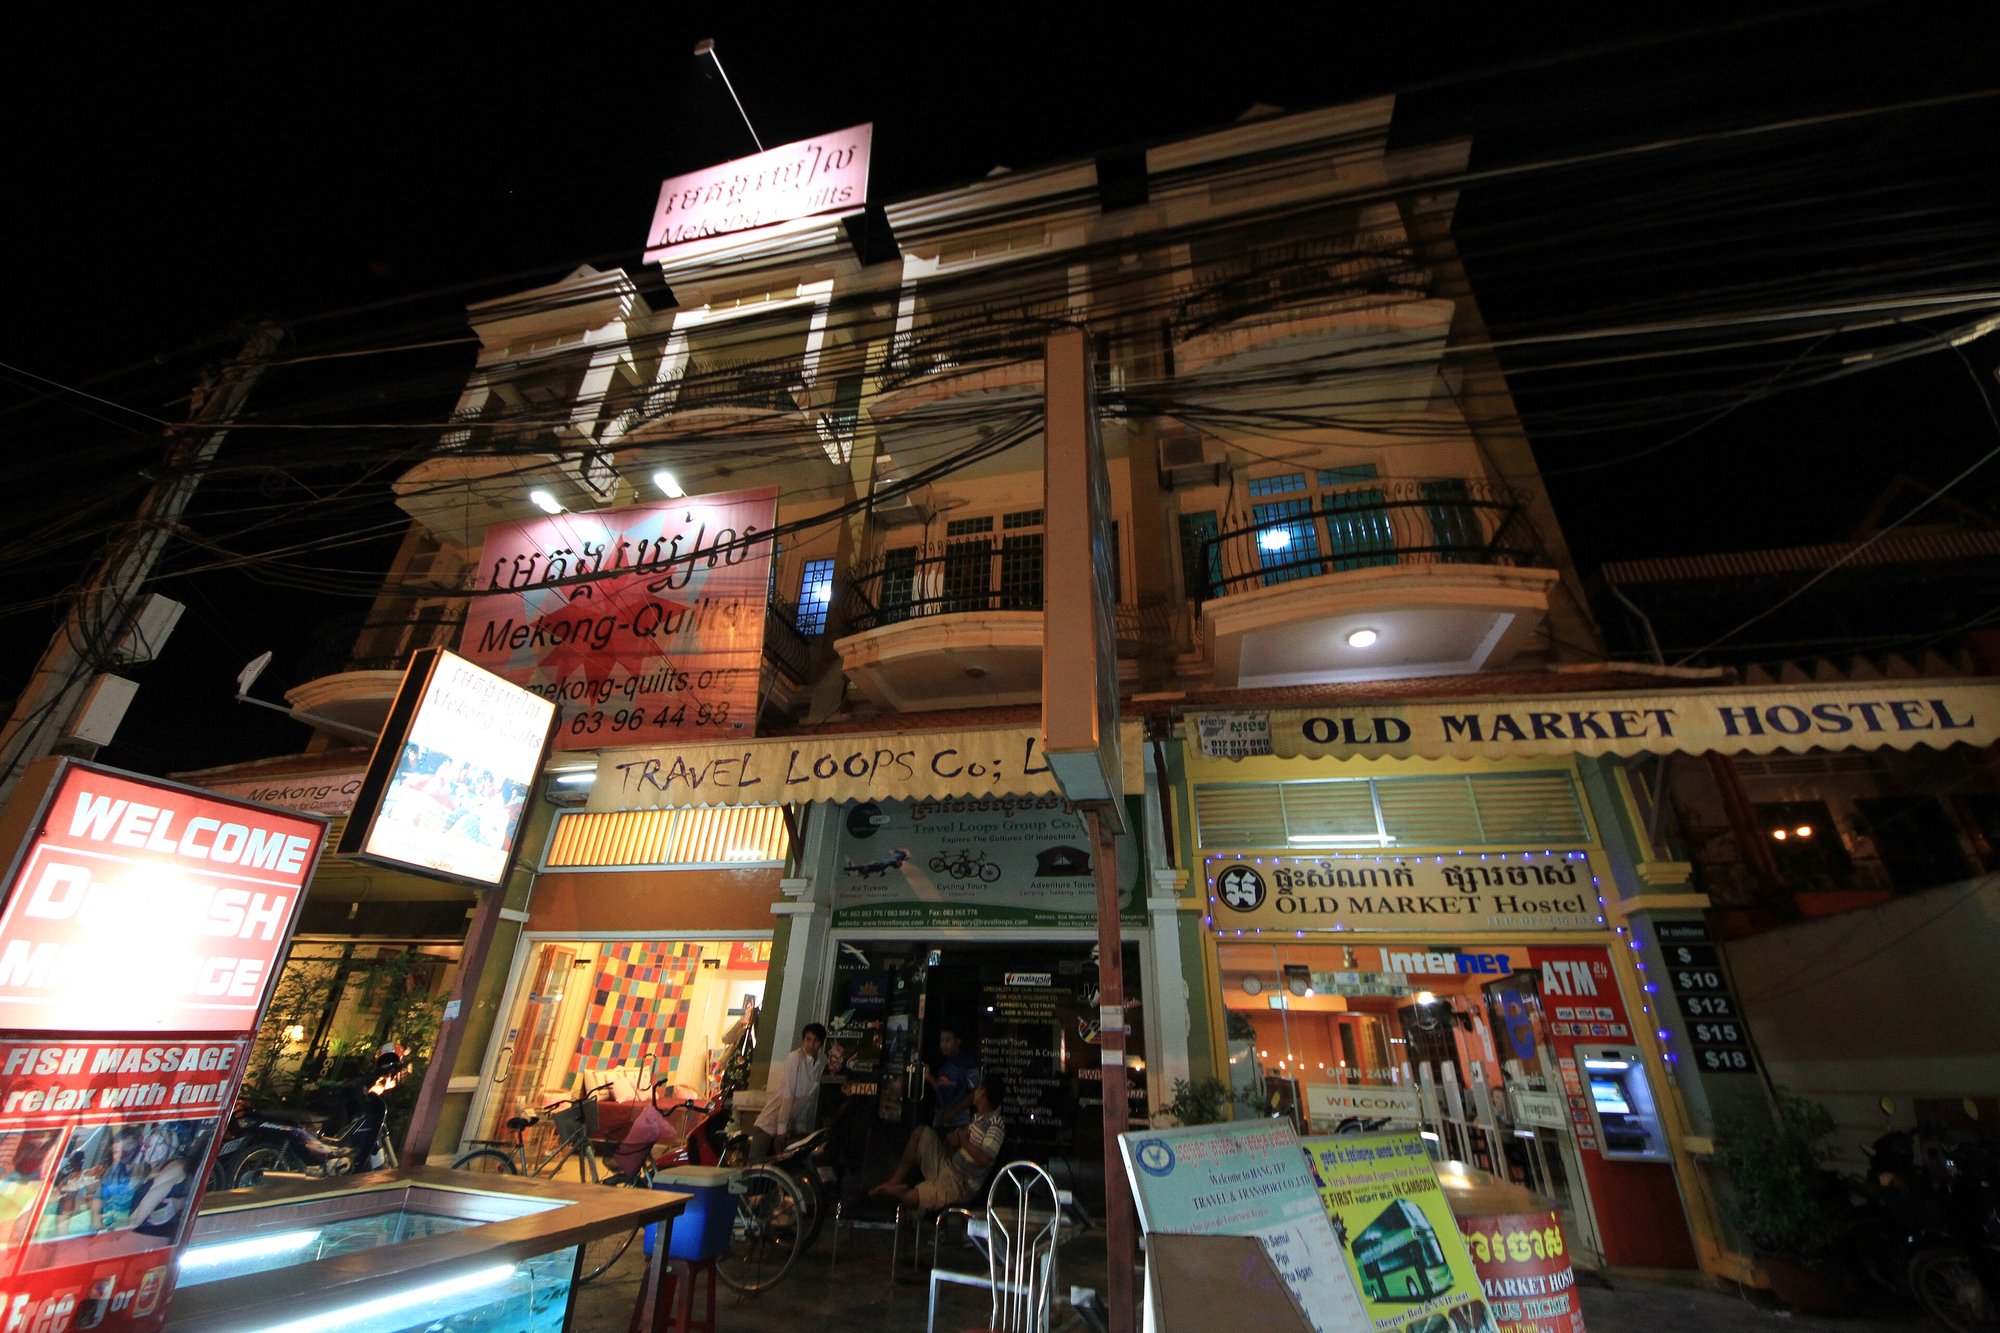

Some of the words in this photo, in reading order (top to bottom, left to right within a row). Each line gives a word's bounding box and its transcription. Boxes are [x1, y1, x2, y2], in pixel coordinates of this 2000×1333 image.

[571, 710, 604, 736] 63
[611, 707, 645, 732] 96
[653, 704, 686, 728] 44
[1301, 715, 1411, 745] OLD
[1442, 707, 1677, 744] MARKET
[1717, 698, 1976, 737] HOSTEL
[615, 752, 762, 793] TRAVEL
[785, 747, 917, 787] LOOPS
[68, 791, 312, 875] WELCOME
[912, 821, 955, 834] Travel
[958, 820, 999, 835] Loops
[1002, 819, 1047, 834] Group
[941, 836, 971, 845] Explore
[974, 835, 988, 843] The
[989, 834, 1022, 843] Cultures
[1036, 832, 1076, 841] Indochina
[937, 883, 965, 891] Cycling
[967, 882, 988, 890] Tours
[1030, 881, 1071, 889] Adventure
[1072, 881, 1095, 889] Tours
[1275, 896, 1339, 914] OLD
[1347, 894, 1481, 915] MARKET
[1491, 892, 1588, 914] Hostel
[1380, 946, 1514, 975] Internet
[1676, 946, 1692, 965] $
[1541, 960, 1598, 997] ATM
[1678, 971, 1719, 990] $10
[1687, 996, 1729, 1015] $12
[1696, 1023, 1738, 1043] $15
[2, 1047, 90, 1075] FISH
[90, 1046, 238, 1074] MASSAGE
[1704, 1050, 1747, 1070] $18
[1326, 1067, 1361, 1079] OPEN
[4, 1086, 96, 1113] relax
[101, 1082, 167, 1106] with
[170, 1080, 231, 1104] fun!
[1326, 1095, 1412, 1111] WELCOM
[1209, 1171, 1242, 1187] Welcome
[1192, 1192, 1229, 1211] TRAVEL
[1238, 1181, 1283, 1201] TRANSPORT
[1329, 1189, 1354, 1208] FIRST
[1392, 1182, 1403, 1197] IN
[1401, 1177, 1438, 1196] CAMBODIA
[1483, 1275, 1547, 1298] MARKET
[3, 1292, 76, 1333] Free
[110, 1289, 136, 1312] or
[1375, 1314, 1405, 1329] Sleeper
[1407, 1306, 1423, 1318] Bed
[1523, 1293, 1571, 1320] TICKET
